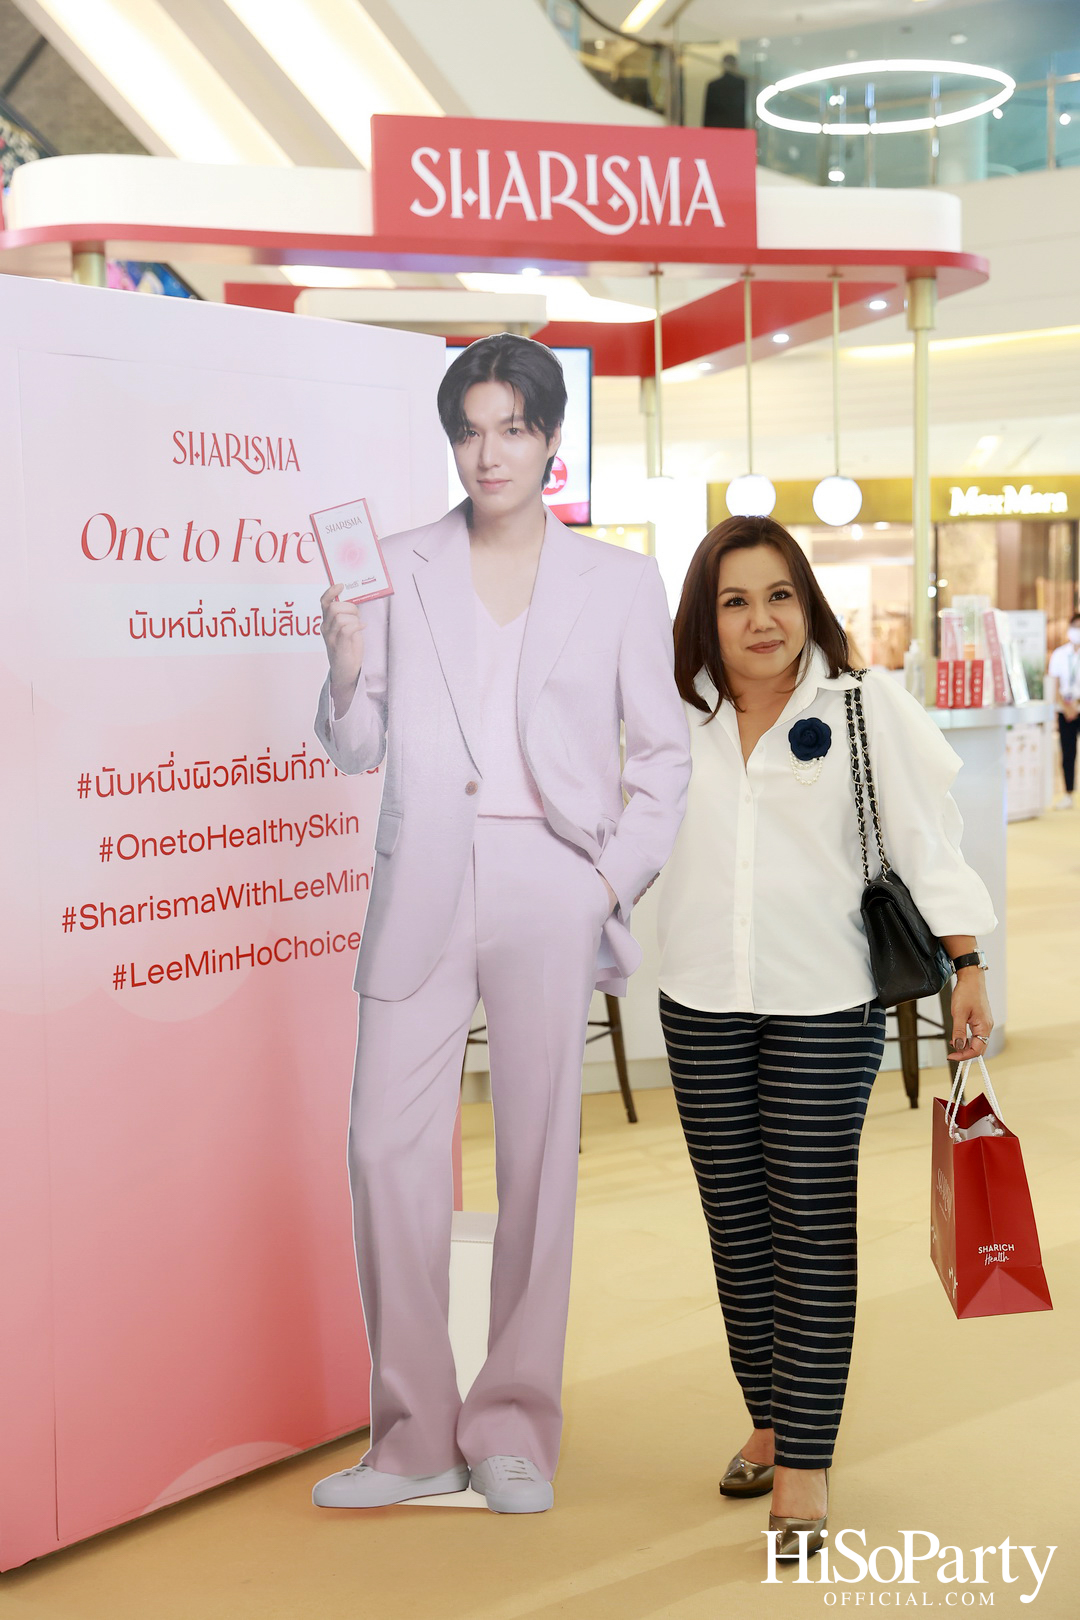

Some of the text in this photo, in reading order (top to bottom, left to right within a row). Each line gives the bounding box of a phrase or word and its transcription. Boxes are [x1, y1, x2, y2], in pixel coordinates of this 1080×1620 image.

[409, 146, 726, 236] SHARISMA
[172, 430, 301, 475] SHARISMA
[80, 512, 170, 562] One
[182, 520, 220, 563] to
[325, 516, 362, 534] SHARISMA
[99, 812, 360, 863] #OnetoHealthySkin
[61, 867, 374, 933] #SharismaWithLeeMin
[112, 930, 361, 991] #LeeMinHoChoice
[978, 1243, 1015, 1254] SHARICH
[984, 1251, 1010, 1266] Health
